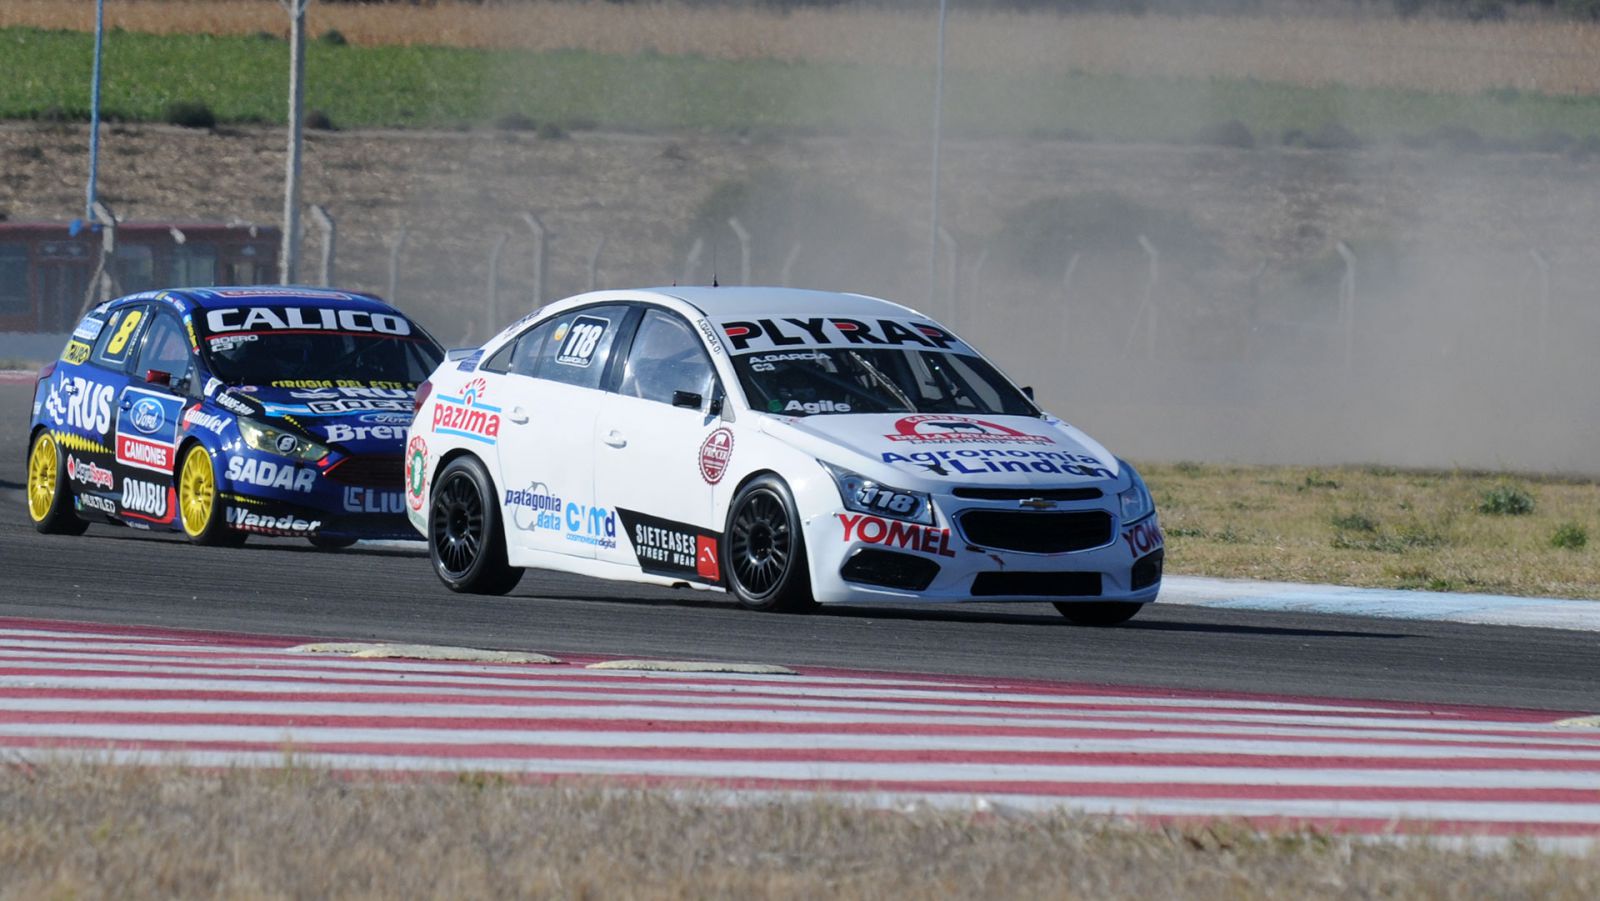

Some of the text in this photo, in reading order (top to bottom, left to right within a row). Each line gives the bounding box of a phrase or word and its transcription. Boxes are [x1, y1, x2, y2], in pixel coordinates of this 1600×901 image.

[107, 310, 143, 355] 8
[206, 307, 411, 336] CALICO
[210, 334, 259, 346] BOERO
[211, 342, 234, 352] C3
[564, 323, 602, 358] 118
[749, 353, 832, 364] A.GARCIA
[752, 362, 776, 373] C3
[336, 379, 363, 388] DEL
[369, 380, 403, 389] ESTE
[338, 387, 417, 399] RU
[67, 377, 114, 434] RUS
[136, 402, 158, 430] Ford
[784, 400, 851, 414] Agile
[432, 403, 500, 437] pazima
[124, 440, 167, 466] CAMIONES
[278, 436, 295, 450] 8
[225, 456, 317, 493] SADAR
[121, 477, 167, 516] OMBU
[504, 489, 562, 513] patagonia
[861, 486, 917, 514] 118
[226, 506, 321, 531] Wander
[537, 513, 561, 531] data
[635, 523, 696, 556] SIETEASES
[838, 513, 956, 557] YOMEL
[637, 546, 696, 568] STREET WEAR
